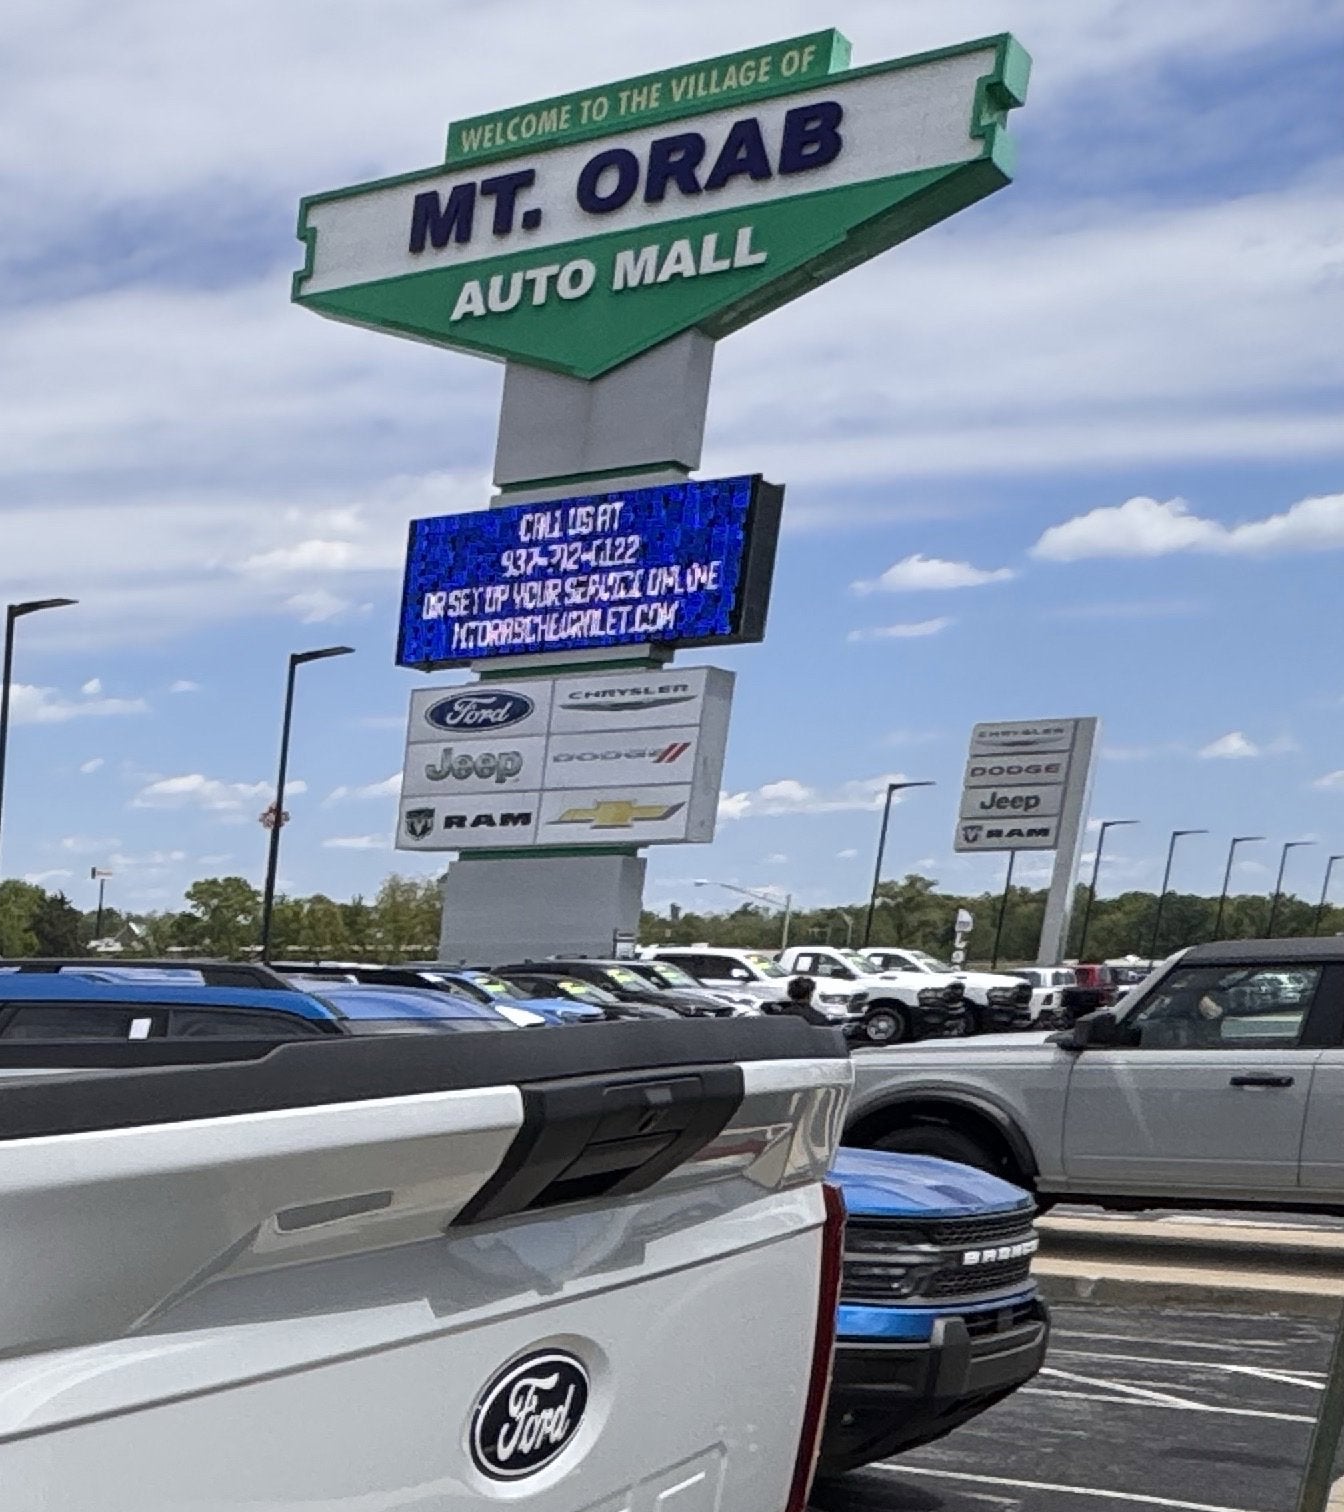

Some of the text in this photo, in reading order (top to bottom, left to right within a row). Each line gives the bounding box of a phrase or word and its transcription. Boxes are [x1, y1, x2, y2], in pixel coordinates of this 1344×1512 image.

[461, 45, 817, 152] WELCOME TO THE VILLAGE OF
[409, 100, 845, 255] MT. ORAB
[450, 226, 768, 323] AUTO MALL
[597, 501, 625, 532] AT
[445, 684, 690, 726] Ford CHRYSLER
[425, 747, 524, 784] Jeep
[969, 763, 1062, 778] DODGE
[979, 791, 1041, 812] Jeep
[443, 812, 533, 830] RAM
[986, 827, 1050, 838] RAM
[496, 1372, 576, 1462] Ford
